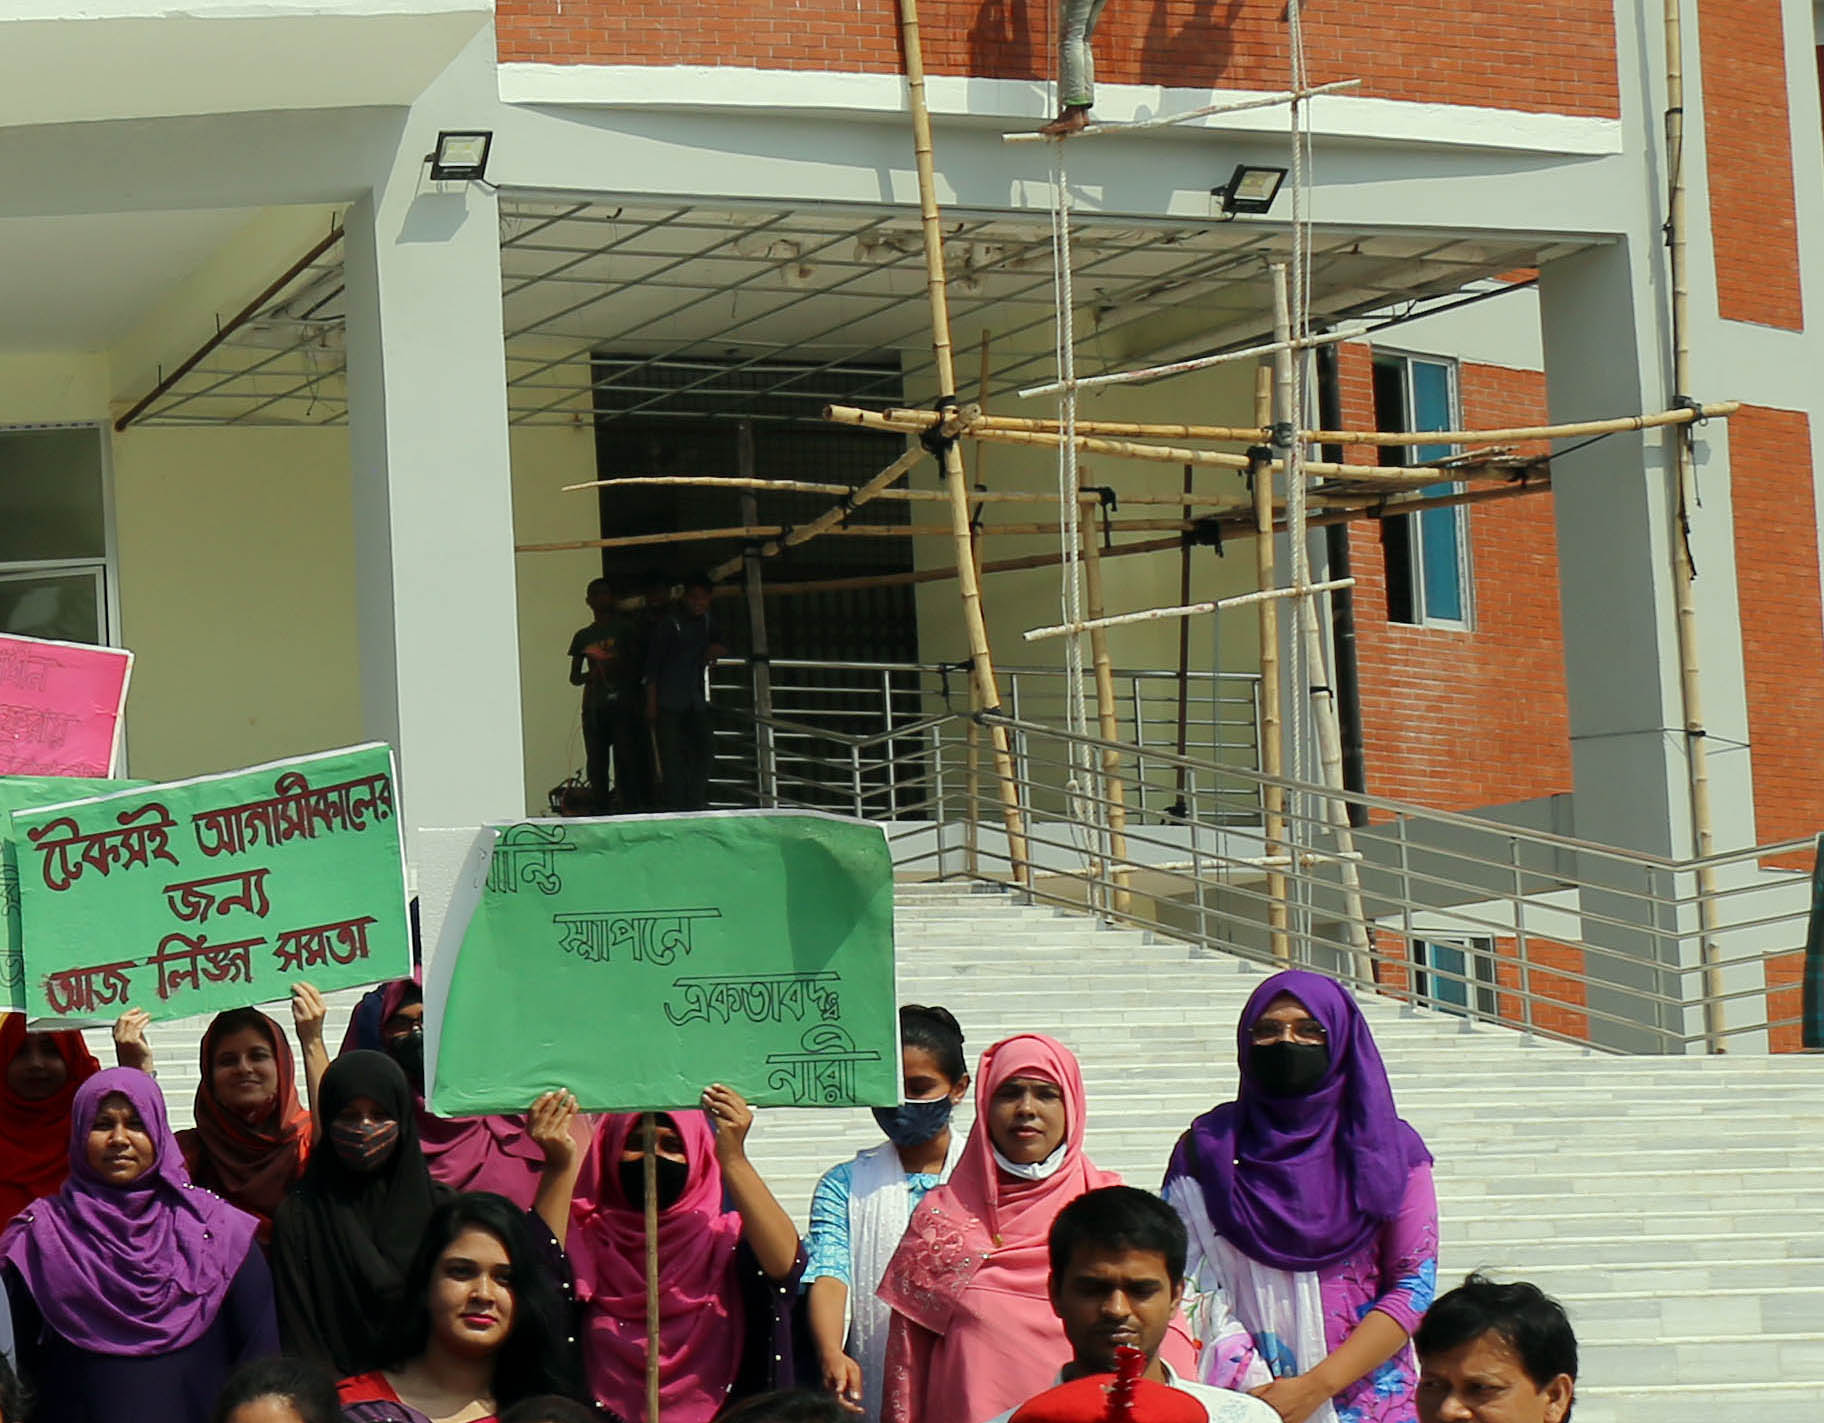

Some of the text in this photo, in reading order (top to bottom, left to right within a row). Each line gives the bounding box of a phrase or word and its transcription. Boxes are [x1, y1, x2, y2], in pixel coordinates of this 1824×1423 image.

[27, 772, 394, 892] টেকসই আগামীকালের
[486, 822, 577, 895] ান্তি
[162, 868, 271, 924] জন্য
[42, 960, 138, 1015] আজ
[273, 915, 378, 973] সমতা
[766, 1023, 881, 1104] নারী
